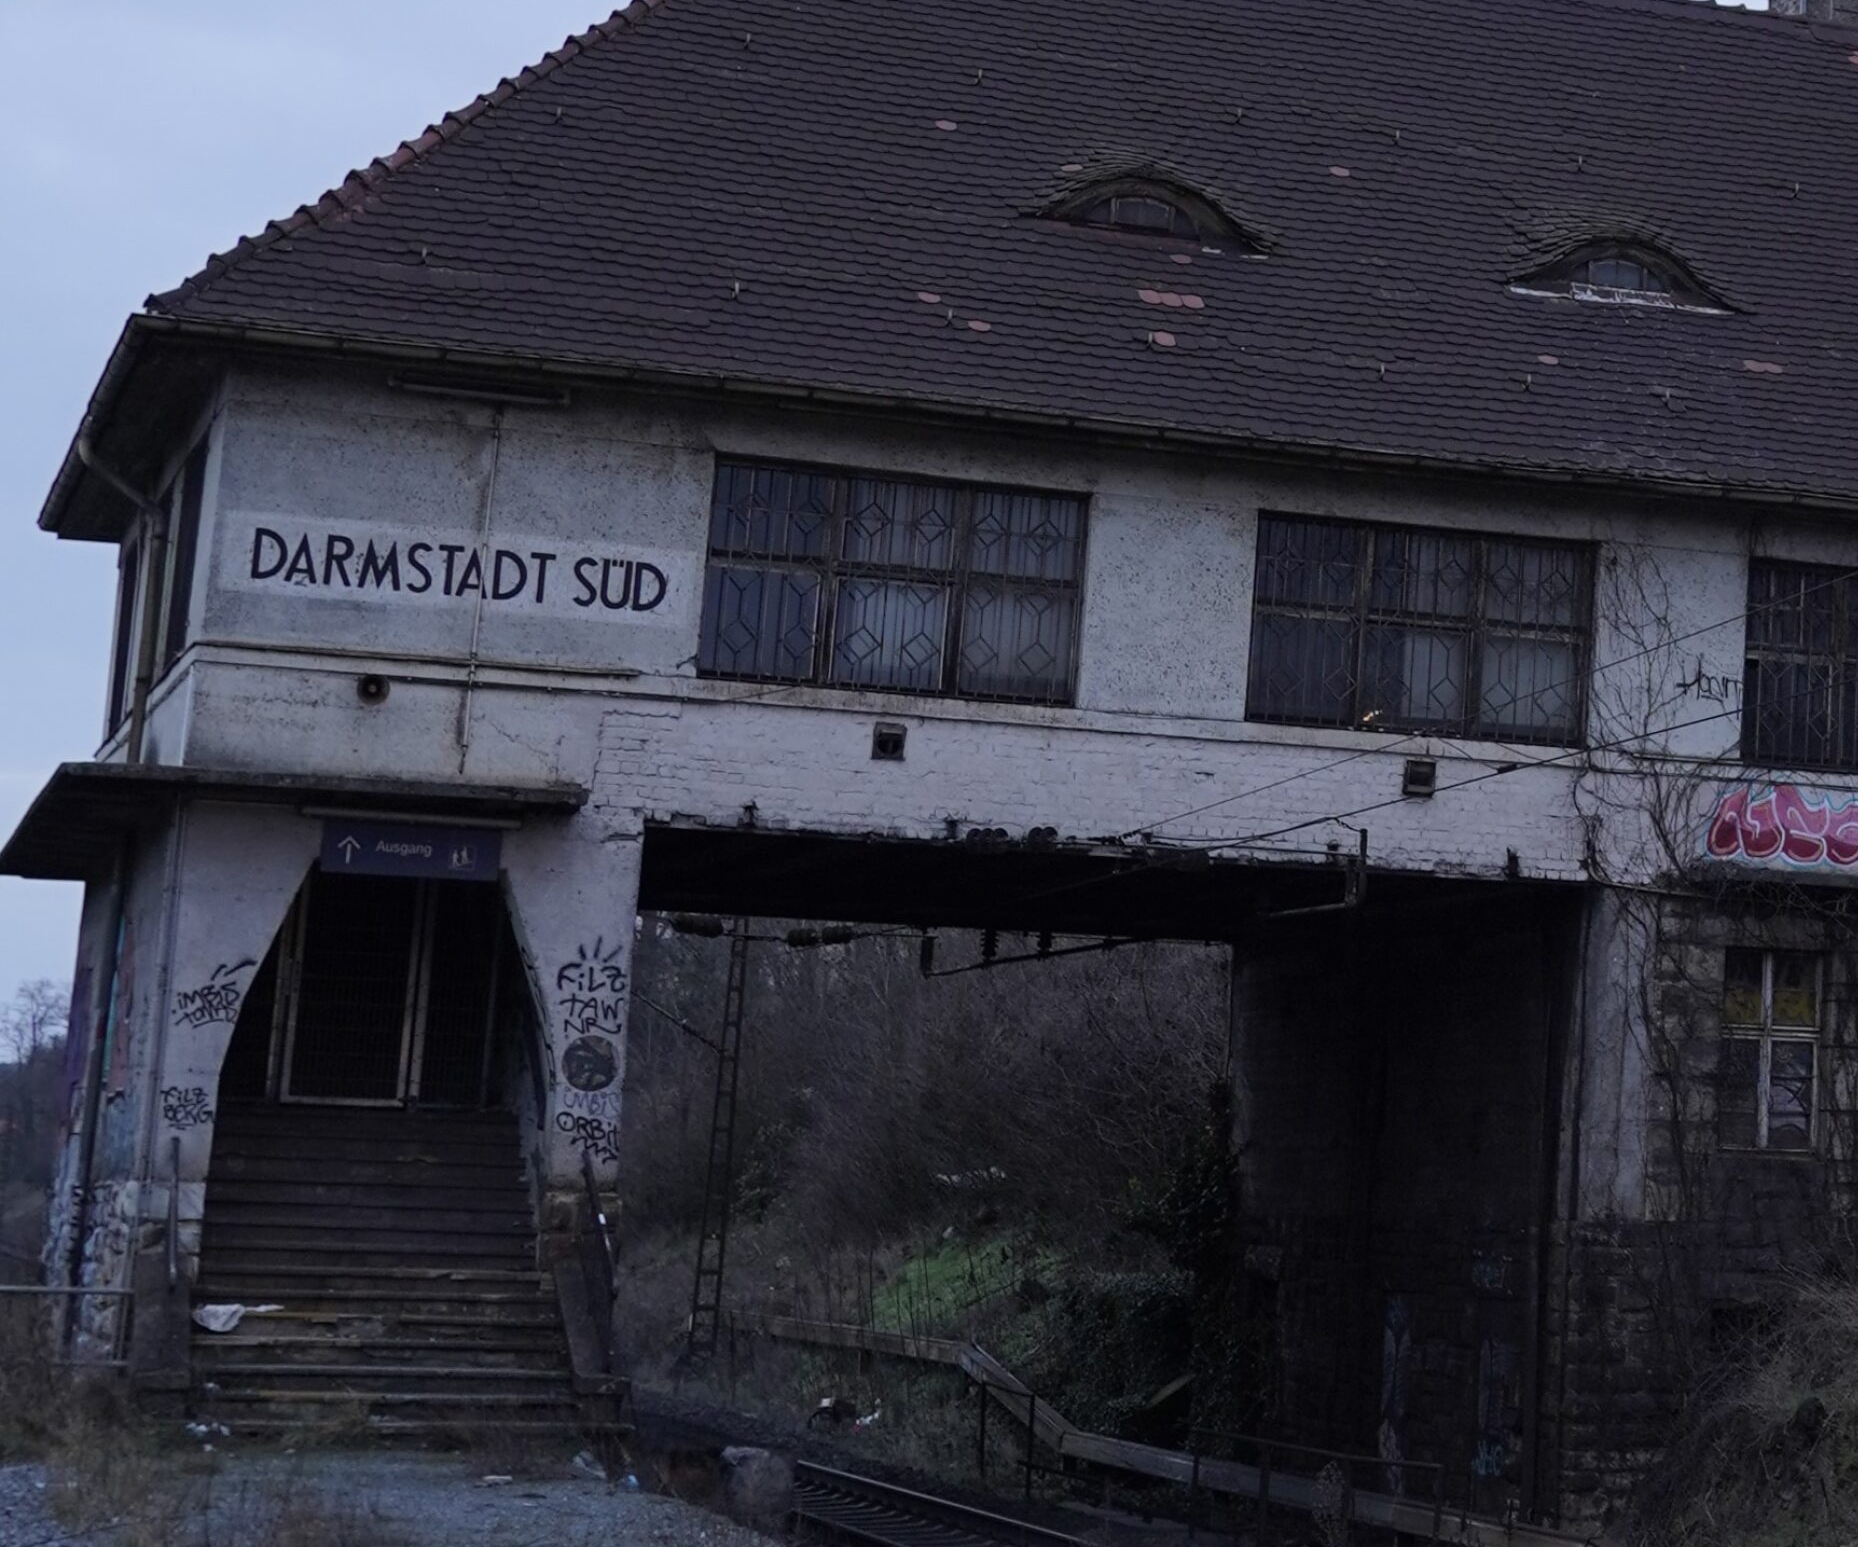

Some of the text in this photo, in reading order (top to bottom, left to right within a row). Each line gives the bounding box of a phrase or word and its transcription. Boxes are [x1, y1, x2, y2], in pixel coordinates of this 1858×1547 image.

[250, 527, 669, 612] DARMSTADT SÜD
[375, 840, 433, 857] Ausgang
